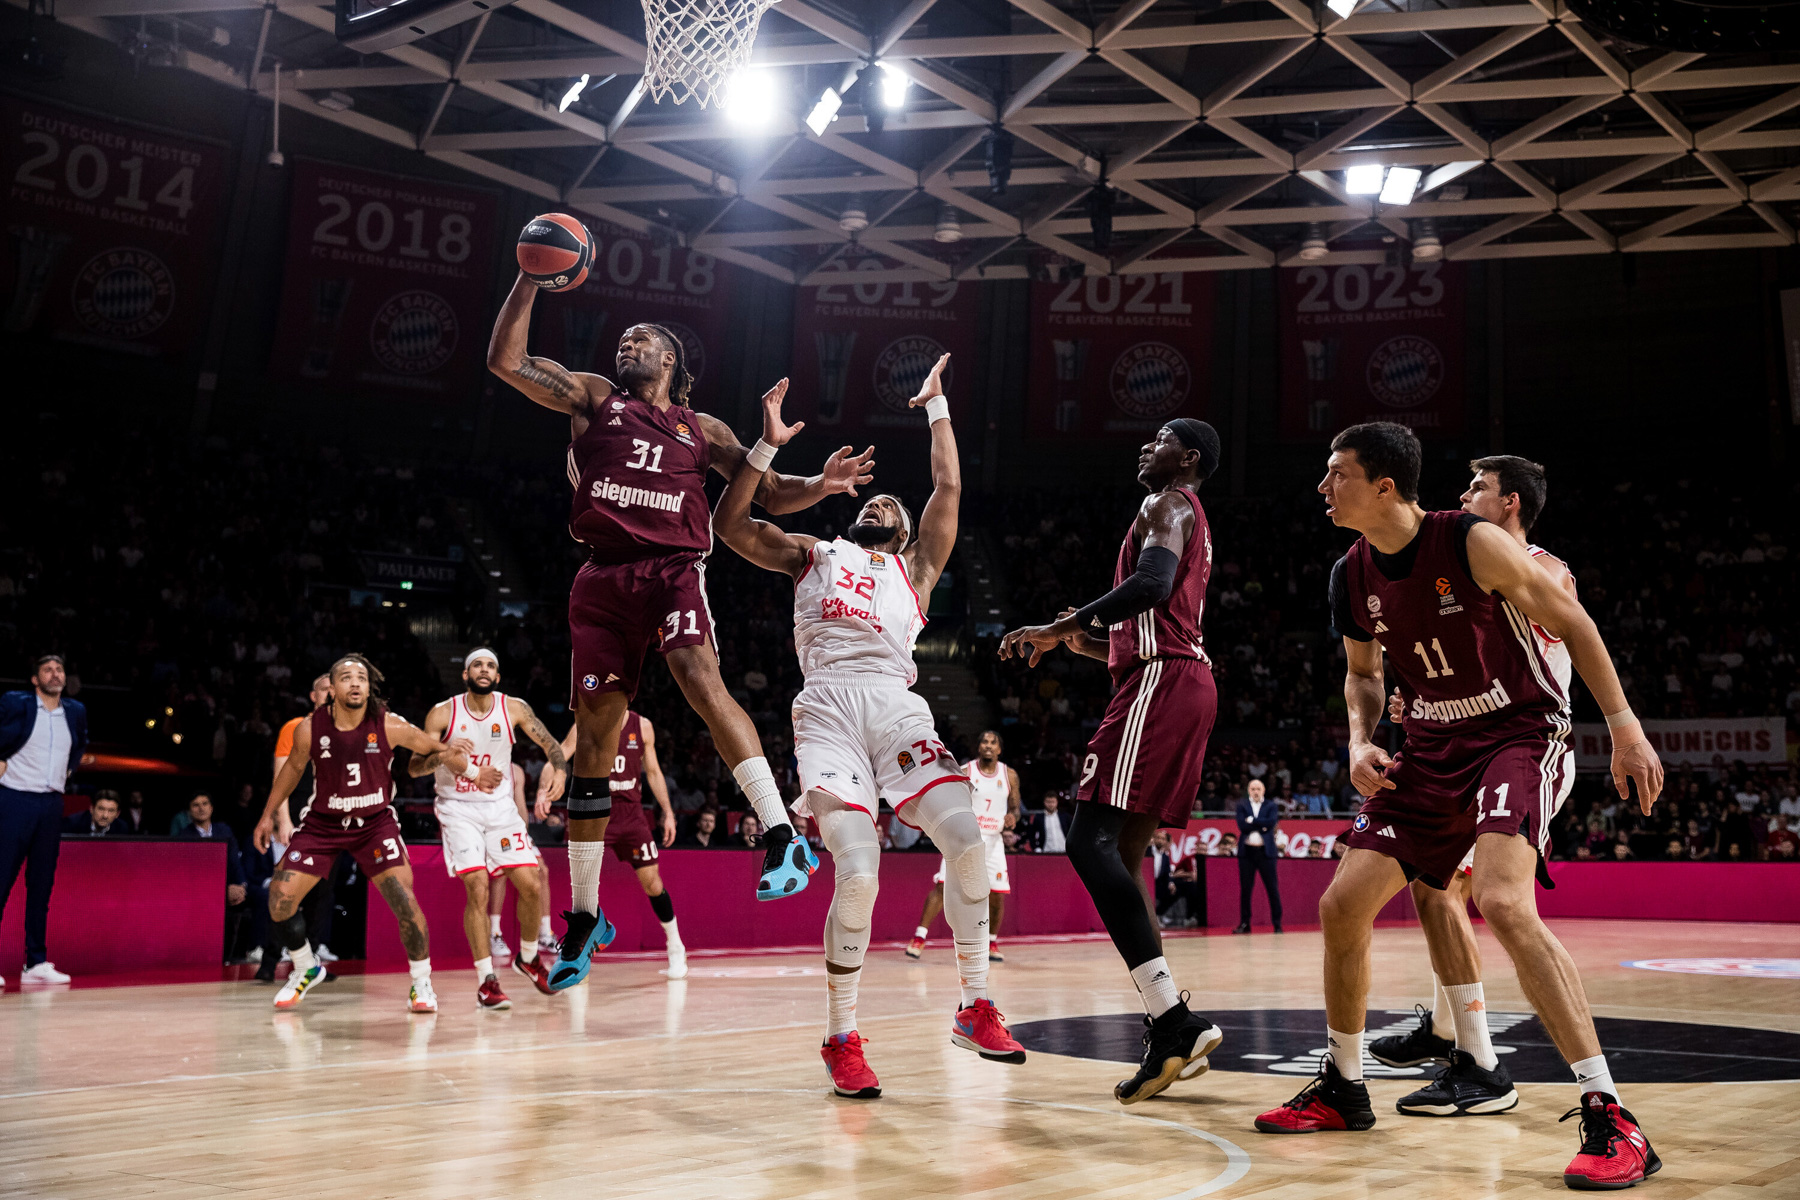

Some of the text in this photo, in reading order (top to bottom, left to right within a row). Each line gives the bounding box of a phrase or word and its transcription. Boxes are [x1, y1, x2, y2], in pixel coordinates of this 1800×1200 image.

[21, 111, 201, 167] DEUTSCHER MEISTER
[15, 130, 195, 219] 2014
[10, 186, 189, 236] FC BAYERN BASKETBALL
[318, 177, 476, 213] DEUTSCHER POKALSIEGER
[313, 194, 472, 264] 2018
[83, 252, 170, 296] FC BAYERN
[310, 245, 469, 279] FC BAYERN BASKETBALL
[1050, 272, 1192, 315] 2021
[1296, 261, 1444, 313] 2023
[380, 295, 455, 332] FC BAYERN
[815, 305, 957, 321] FC BAYERN BASKETBALL
[1049, 315, 1192, 327] FC BAYERN BASKETBALL
[1296, 308, 1446, 324] FC BAYERN BASKETBALL
[1115, 345, 1185, 377] FC BAYERN
[1388, 339, 1438, 366] BAYERN
[625, 438, 664, 473] 31
[590, 476, 685, 513] siegmund
[377, 561, 456, 582] PAULANER
[836, 565, 875, 601] 32
[665, 609, 701, 642] 31
[1413, 637, 1454, 679] 11
[346, 762, 361, 787] 3
[1079, 752, 1099, 787] 9
[327, 786, 384, 813] siegmund
[985, 799, 992, 812] 7
[1476, 782, 1511, 825] 11
[382, 837, 400, 861] 3
[640, 840, 659, 861] 10
